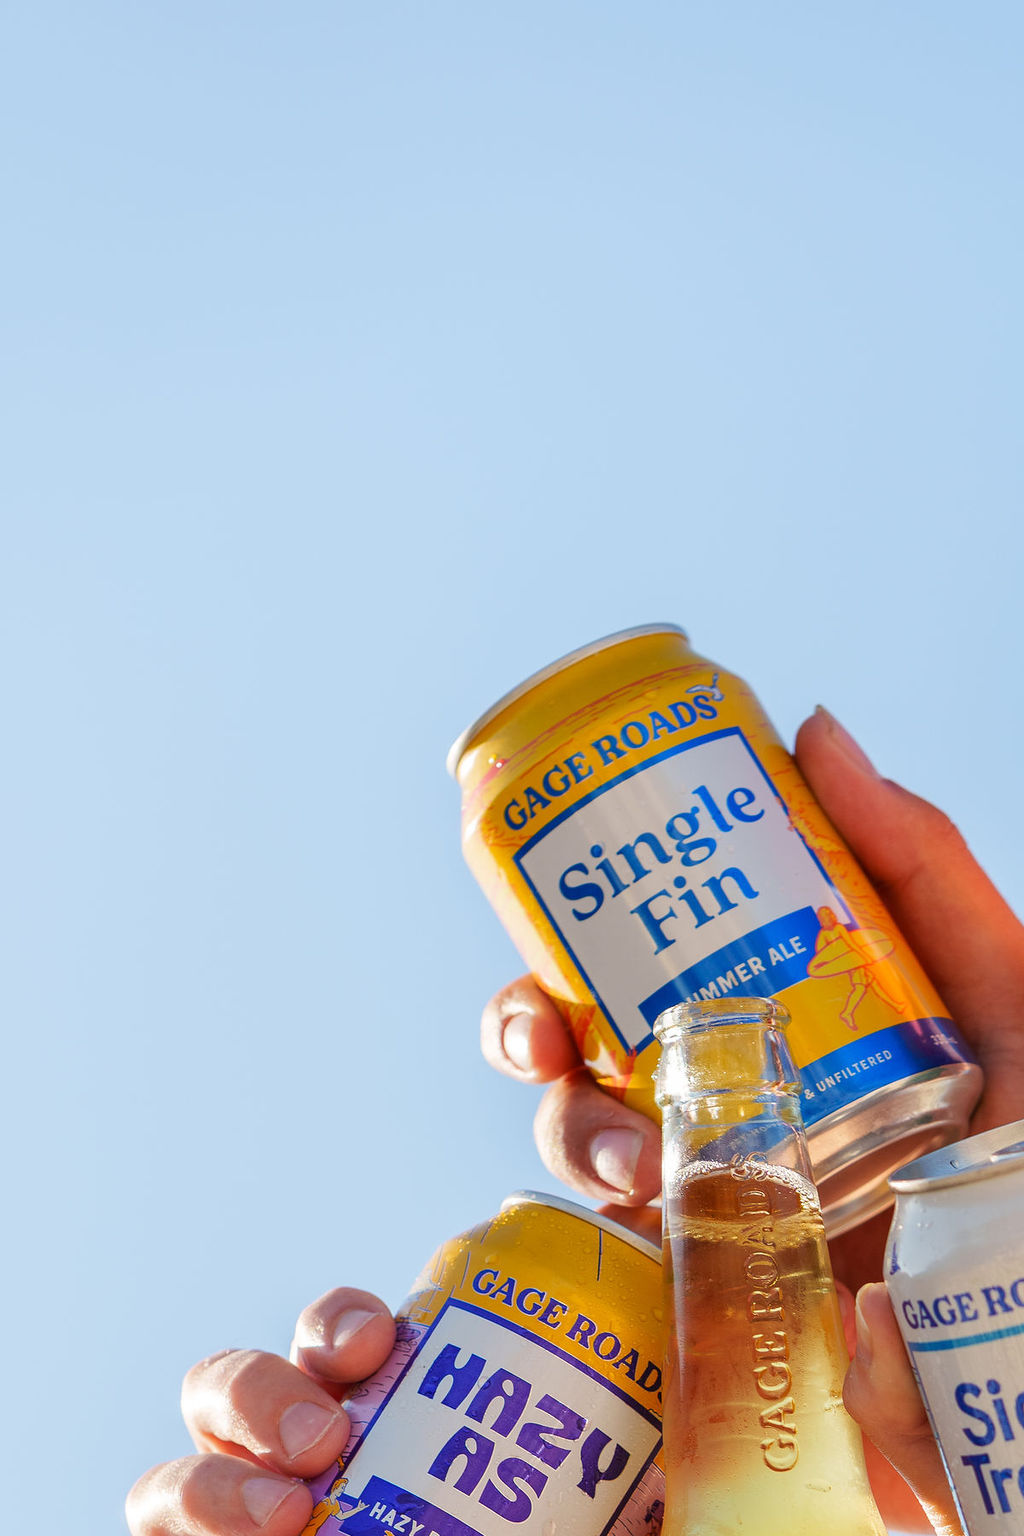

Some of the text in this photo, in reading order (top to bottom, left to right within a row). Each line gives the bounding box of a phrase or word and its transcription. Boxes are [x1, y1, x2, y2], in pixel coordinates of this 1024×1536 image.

[503, 694, 718, 831] GAGE ROADS
[559, 785, 765, 921] Single
[630, 867, 759, 955] Fin
[768, 935, 807, 967] ALE
[804, 1049, 893, 1101] & UNFILTERED
[472, 1268, 662, 1404] GAGE ROAD
[902, 1292, 979, 1330] GAGE
[417, 1343, 630, 1499] HAZY
[753, 1331, 799, 1473] GAGE
[427, 1425, 549, 1523] AS
